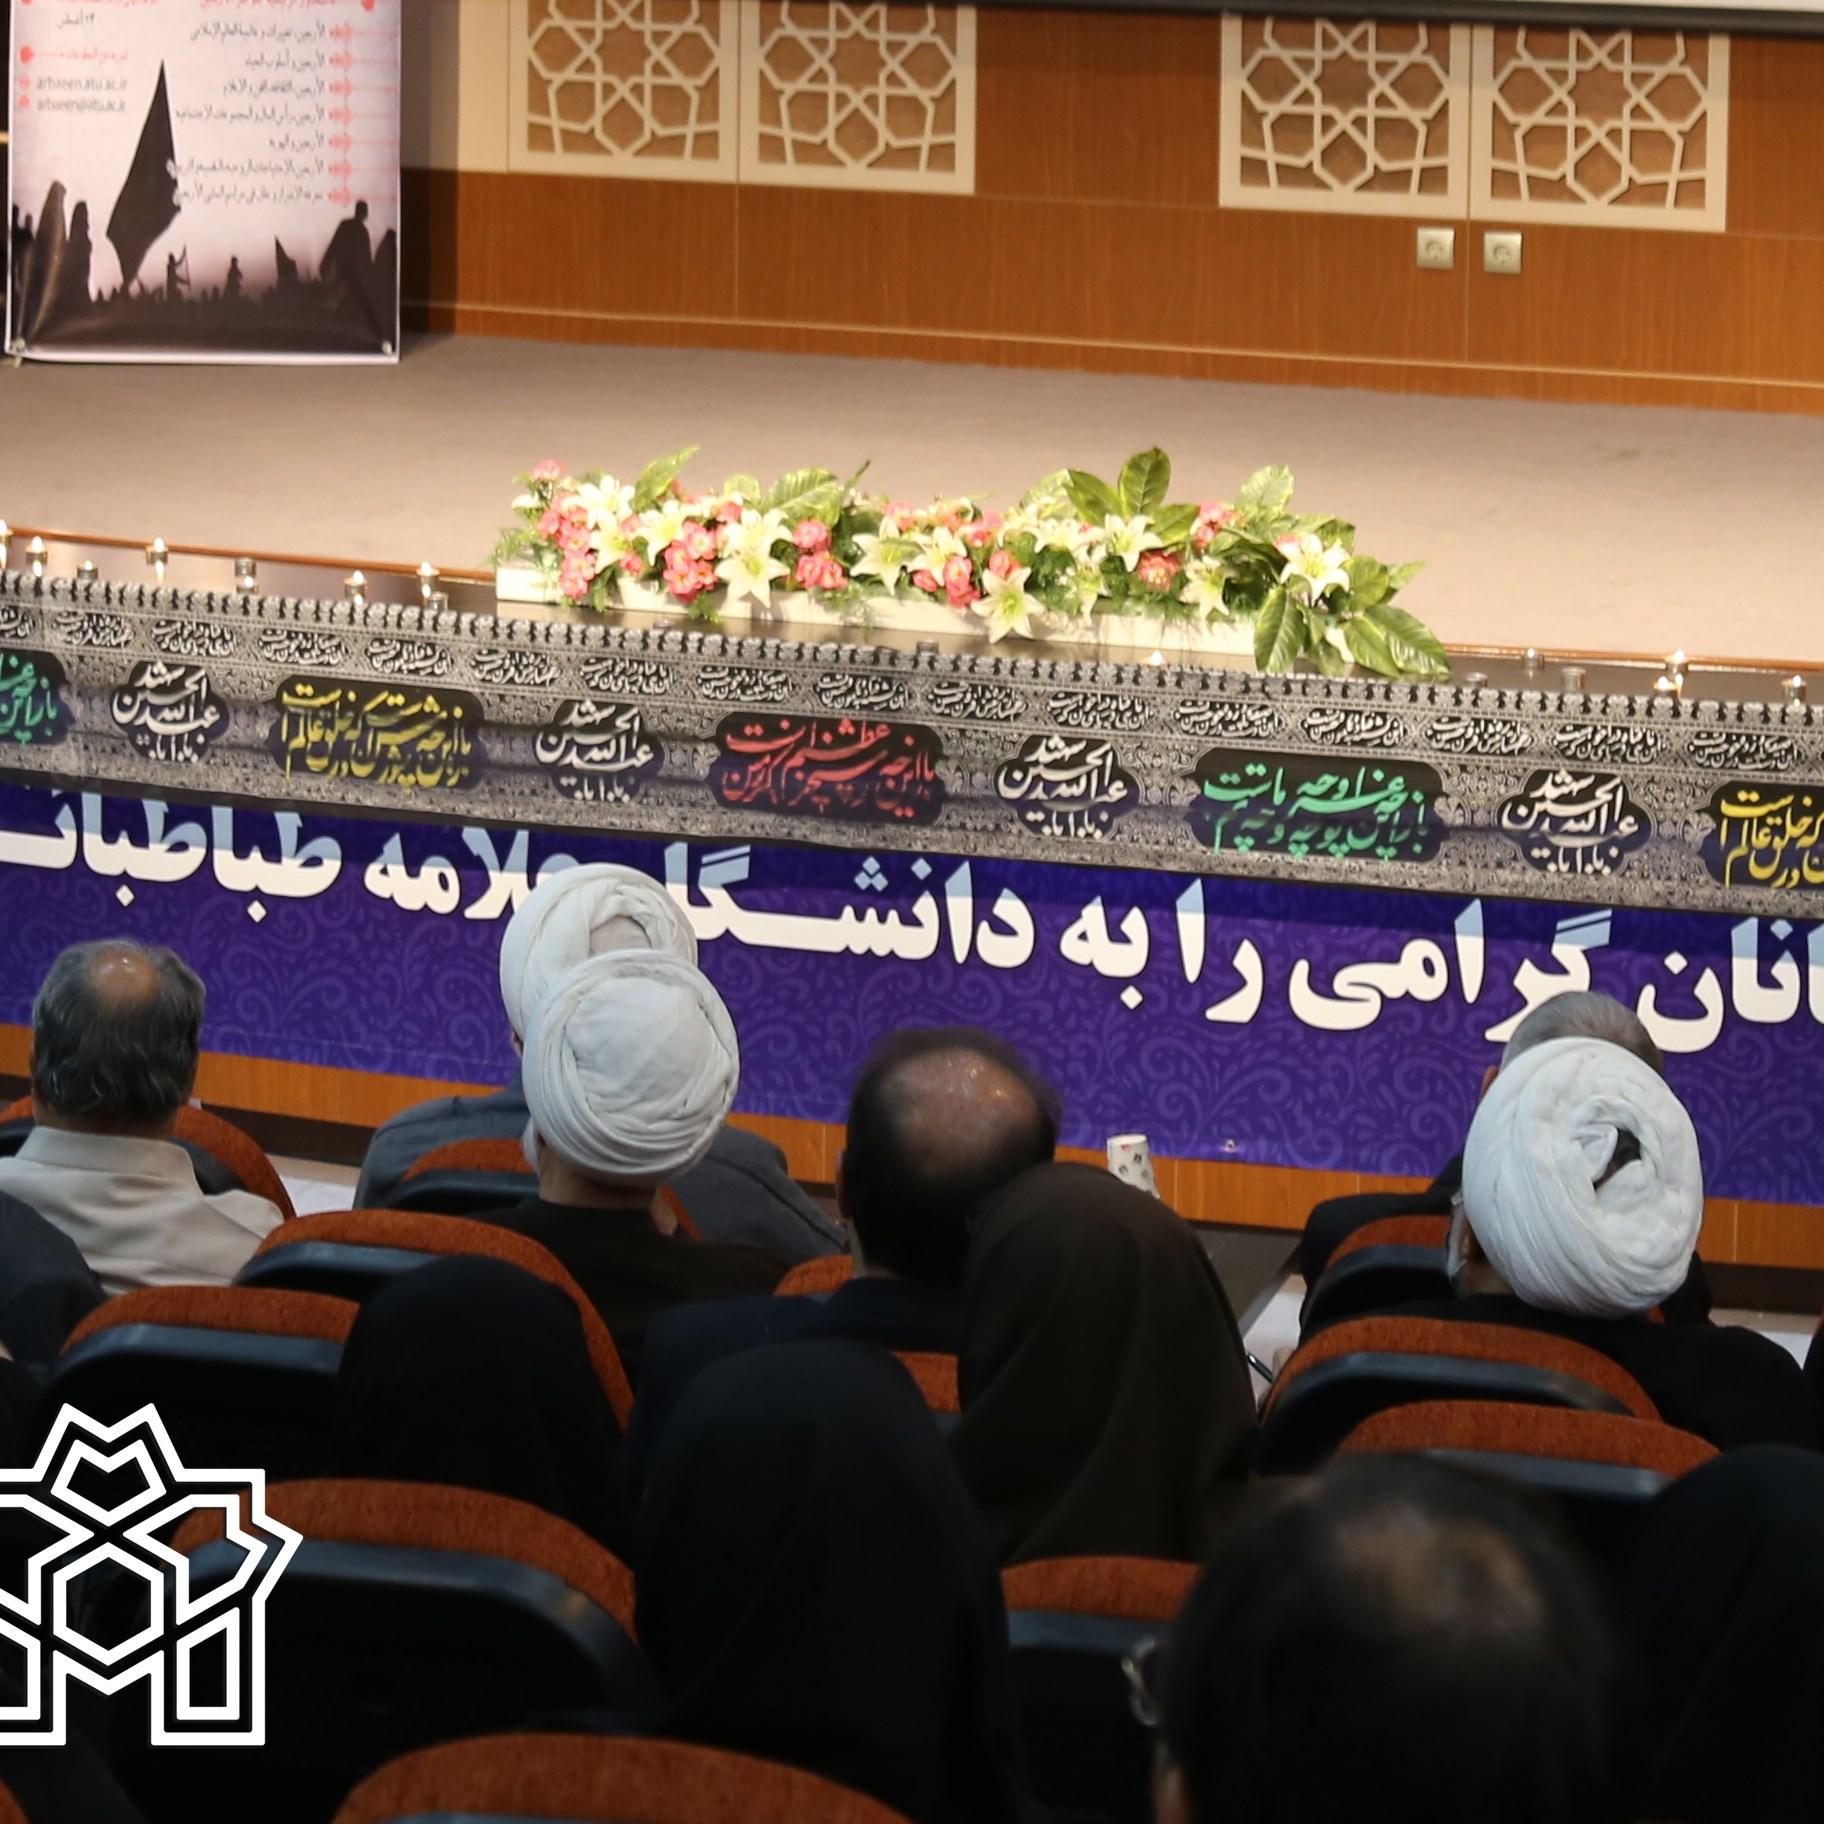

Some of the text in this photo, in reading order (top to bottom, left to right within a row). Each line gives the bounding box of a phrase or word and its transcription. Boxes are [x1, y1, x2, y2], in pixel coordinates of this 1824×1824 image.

[663, 841, 1037, 969] دانشگا
[1058, 893, 1150, 1011] به
[1175, 878, 1264, 1026] را
[1286, 896, 1615, 1043] گرامی
